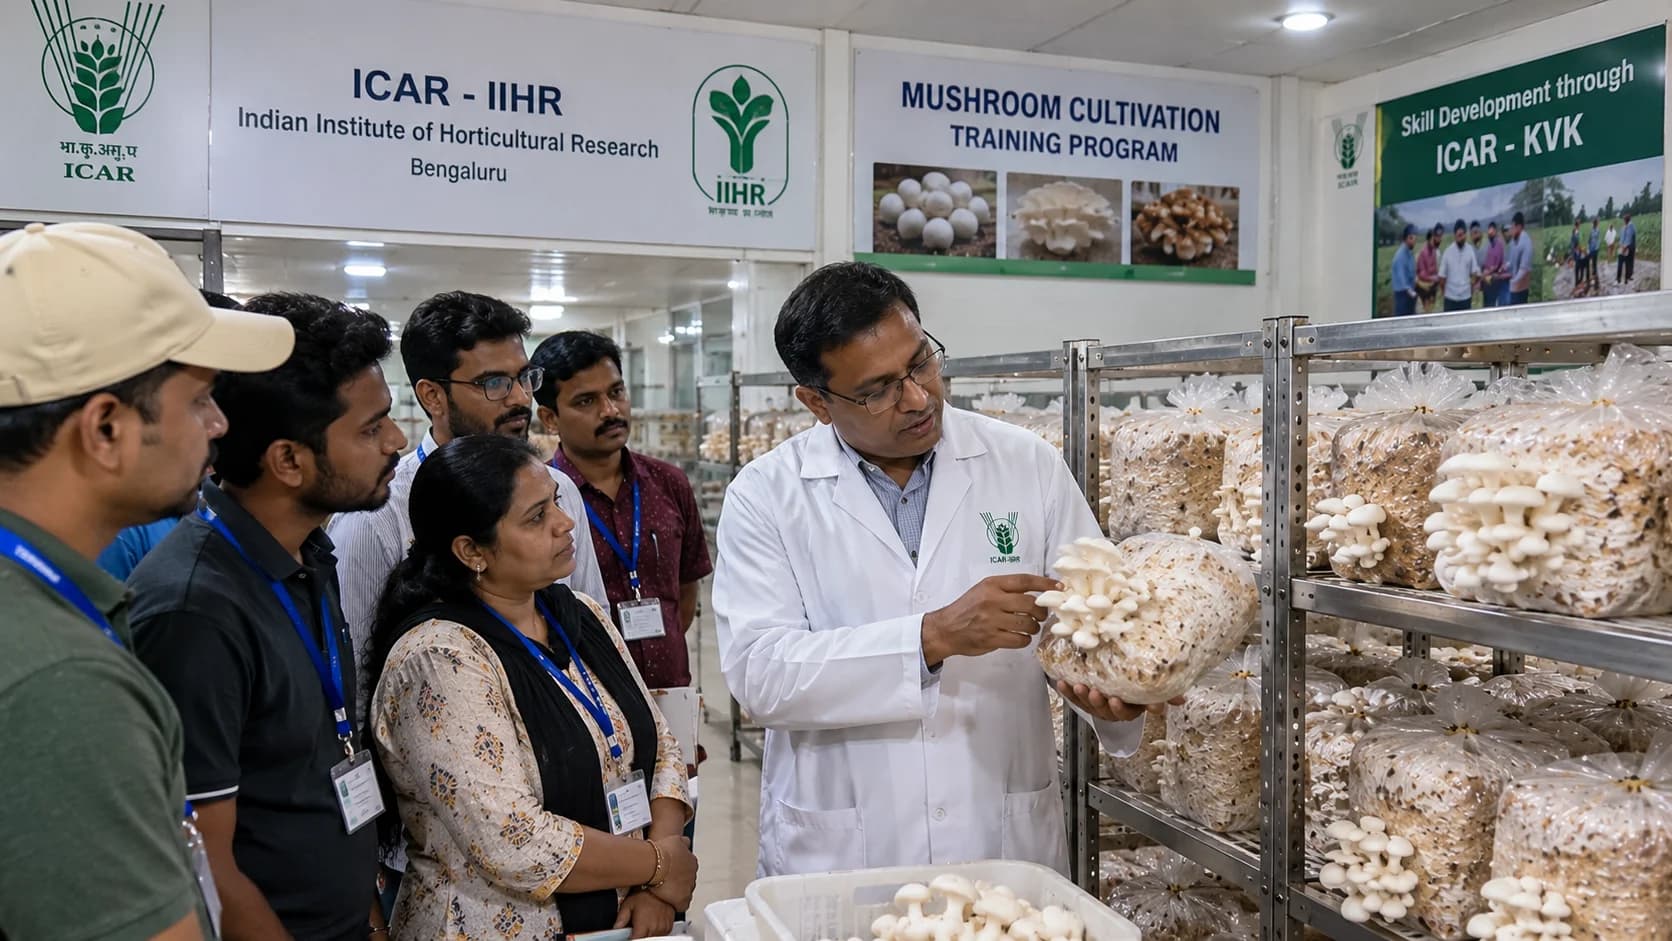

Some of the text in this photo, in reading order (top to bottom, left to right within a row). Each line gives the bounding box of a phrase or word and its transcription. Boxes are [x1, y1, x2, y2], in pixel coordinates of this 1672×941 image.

[352, 68, 563, 117] ICAR - IIHR
[902, 81, 1220, 134] MUSHROOM CULTIVATION
[1401, 58, 1635, 137] Skill Development through
[238, 106, 659, 159] Indian Institute of Horticultural Research
[949, 124, 1178, 163] TRAINING PROGRAM
[1436, 112, 1584, 175] ICAR - KVK
[63, 162, 136, 183] ICAR
[411, 157, 507, 184] Bengaluru
[716, 180, 766, 206] IIHR
